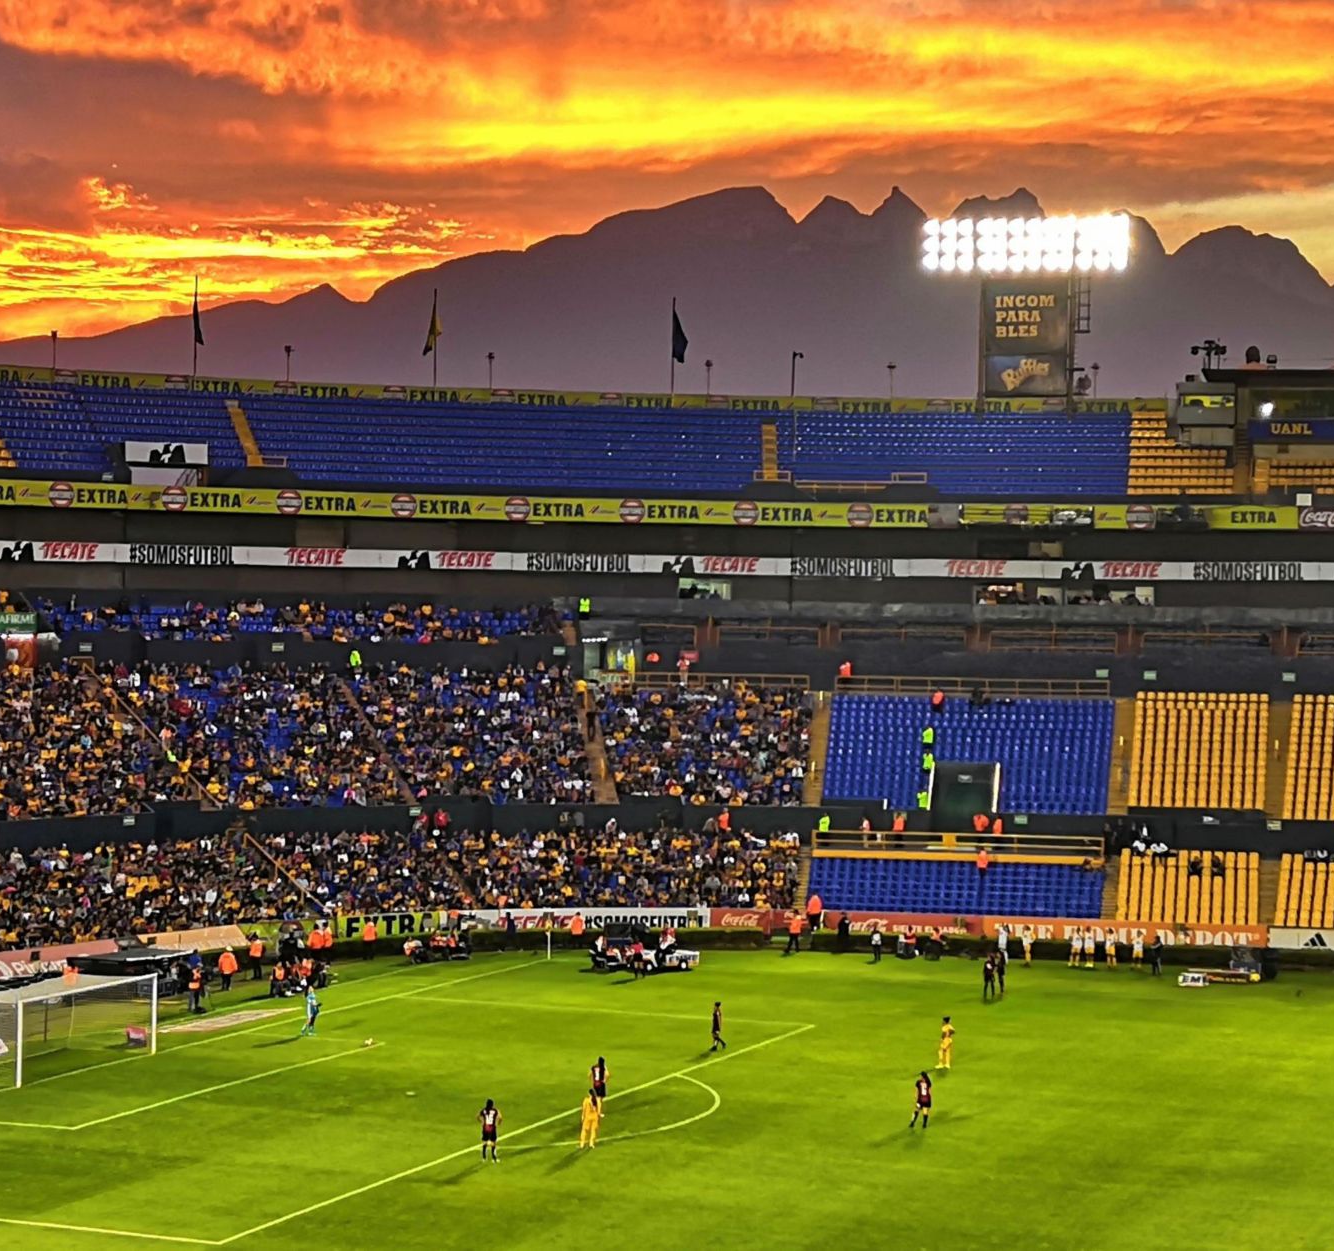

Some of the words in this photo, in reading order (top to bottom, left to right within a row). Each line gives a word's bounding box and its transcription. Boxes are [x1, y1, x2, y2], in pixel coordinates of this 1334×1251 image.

[995, 294, 1055, 308] INCOM
[995, 310, 1041, 324] PARA
[995, 325, 1039, 338] BLES
[1000, 358, 1050, 391] Ruffles
[1270, 423, 1313, 435] UANL
[77, 490, 127, 507] EXTRA
[190, 493, 241, 509] EXTRA
[304, 496, 356, 512] EXTRA
[419, 500, 471, 515] EXTRA
[532, 503, 584, 517] EXTRA
[647, 505, 699, 519] EXTRA
[761, 508, 813, 522] EXTRA
[876, 510, 927, 524] EXTRA
[1231, 510, 1277, 525] EXTRA
[39, 543, 99, 561] TECATE
[129, 544, 234, 566] #SOMOSFUTBOL
[284, 548, 345, 566] TECATE
[436, 551, 496, 568] TECATE
[527, 553, 631, 573] #SOMOSFUTBOL
[698, 556, 760, 573] TECATE
[791, 556, 895, 578] #SOMOSFUTBOL
[944, 560, 1008, 577] TECATE
[1100, 562, 1163, 579] TECATE
[1193, 562, 1304, 582] #SOMOSFUTBOL
